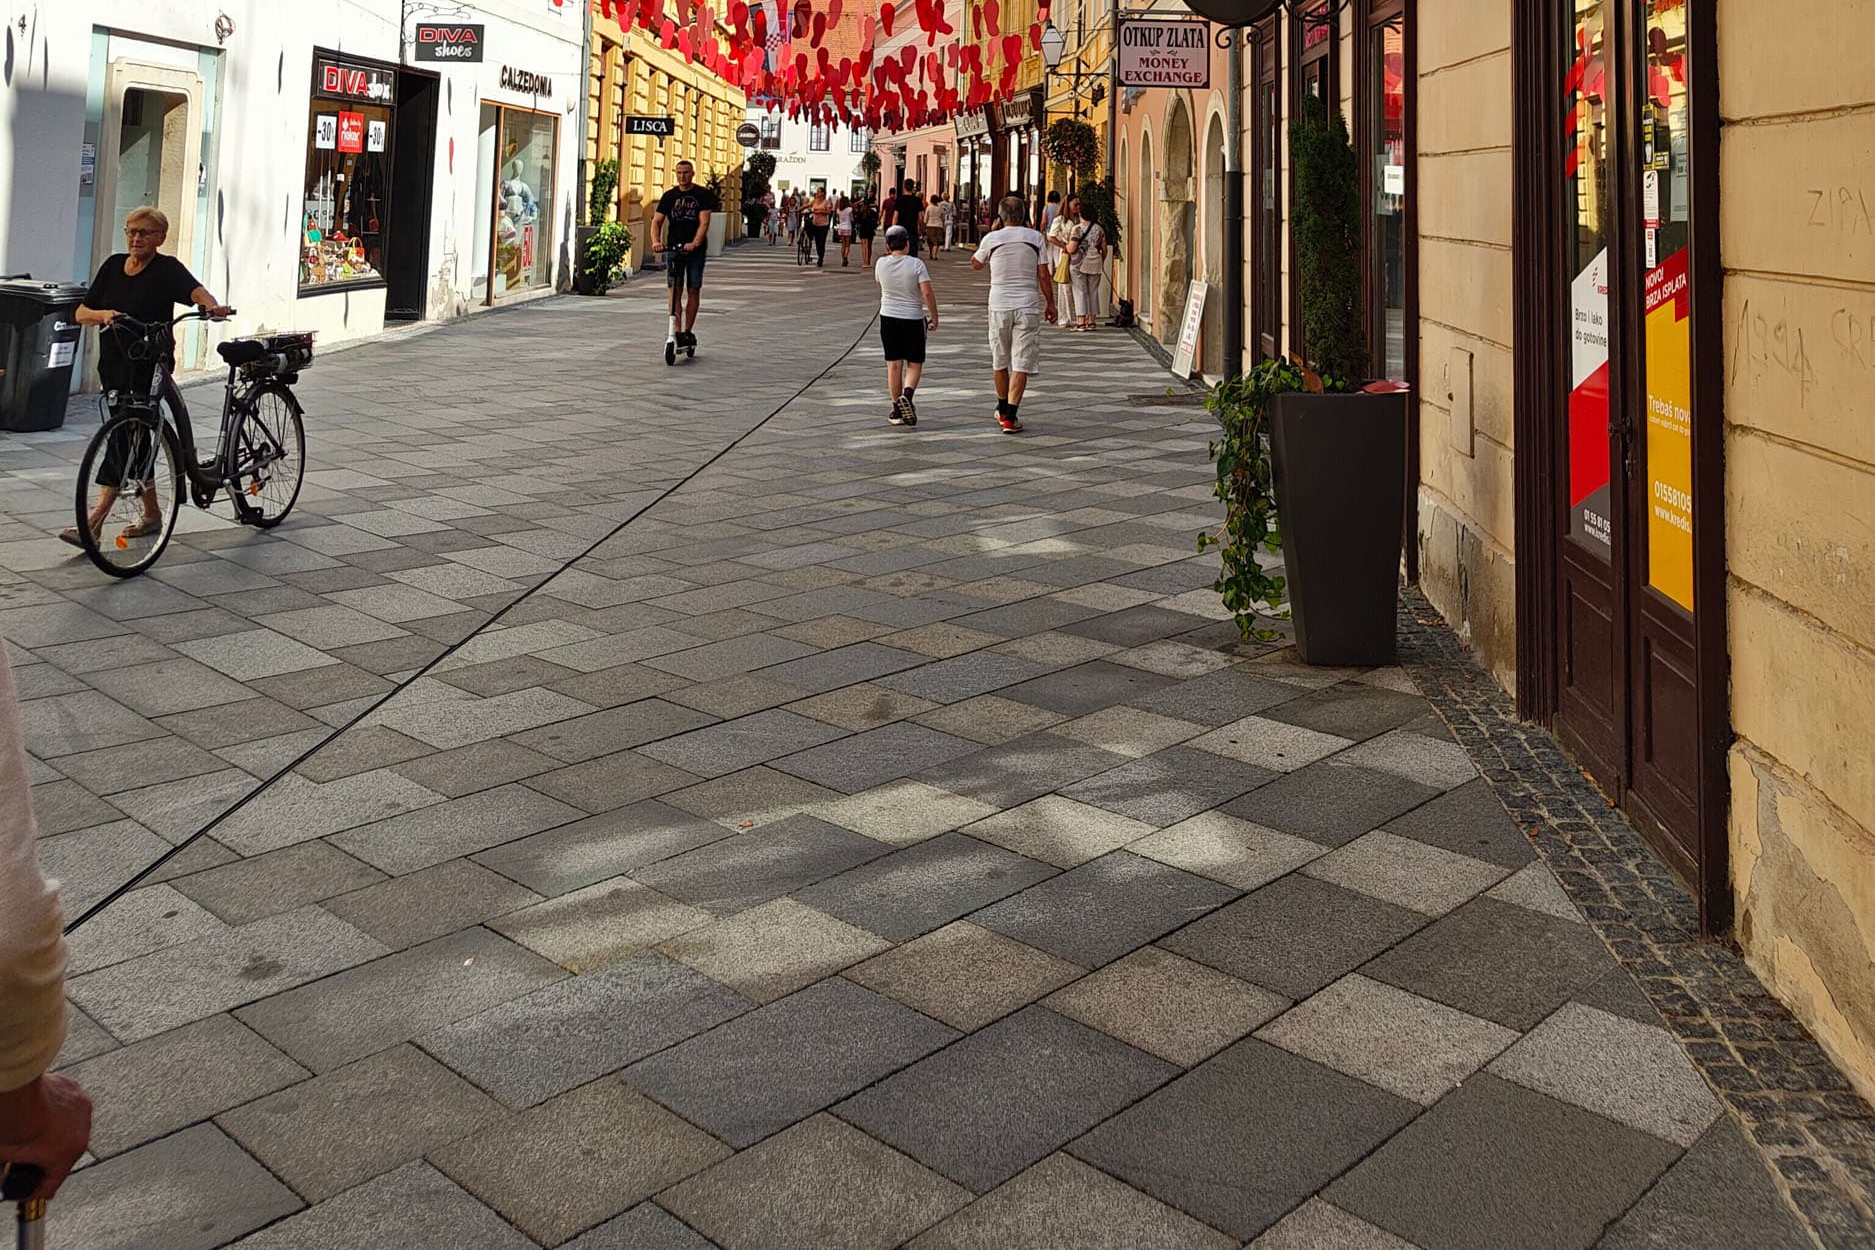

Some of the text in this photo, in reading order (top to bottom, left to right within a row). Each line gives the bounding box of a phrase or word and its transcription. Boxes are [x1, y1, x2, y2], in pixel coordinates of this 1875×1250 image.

[419, 27, 478, 43] DIVA
[1123, 26, 1205, 49] OTKUP ZLATA
[435, 40, 473, 58] shoes
[1139, 57, 1189, 69] MONEY
[323, 65, 368, 96] DIVA
[501, 64, 553, 98] CALZEDONIA
[1125, 71, 1203, 83] EXCHANGE
[633, 120, 668, 133] LISCA
[1645, 266, 1664, 290] NOVO!
[1646, 272, 1687, 310] BRZA ISPLATA
[1575, 328, 1583, 341] do
[1648, 394, 1673, 418] Trebaš
